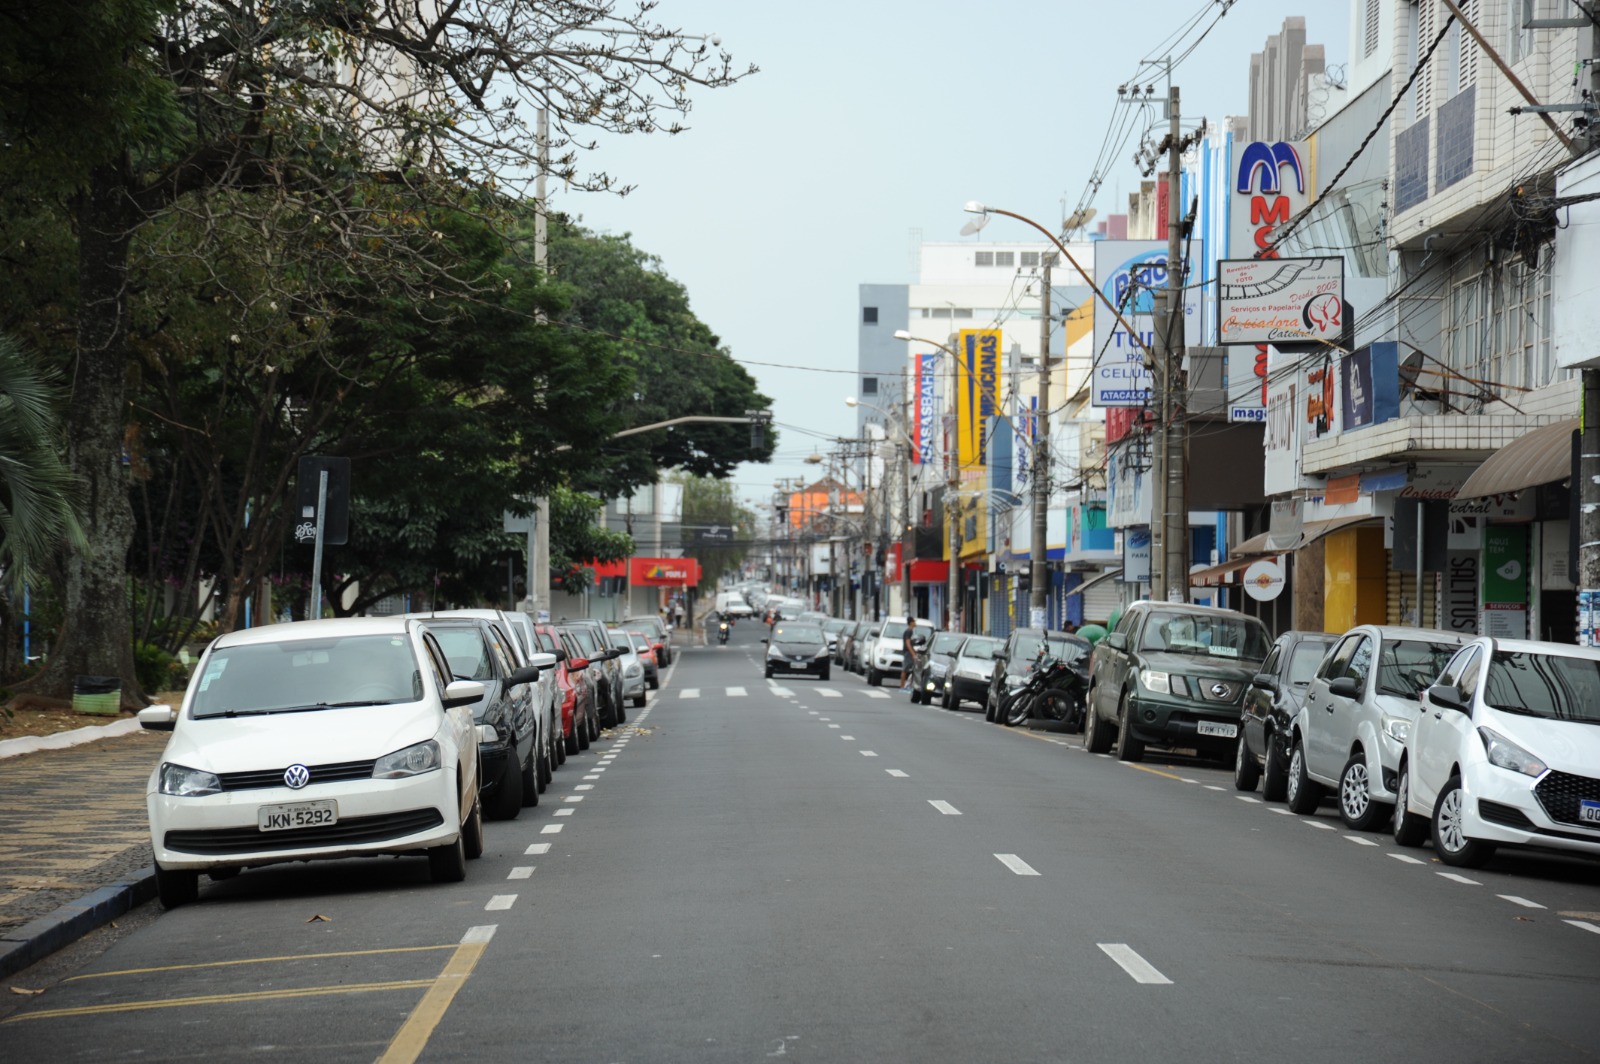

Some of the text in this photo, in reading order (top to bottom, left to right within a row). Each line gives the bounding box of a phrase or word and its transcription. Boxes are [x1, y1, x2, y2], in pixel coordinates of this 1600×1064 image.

[1235, 276, 1253, 284] FOTO
[1289, 280, 1338, 303] Desde 2003
[1230, 305, 1260, 313] Serviços
[1268, 304, 1302, 313] Papelaria
[1102, 391, 1146, 400] ATACADO
[1489, 546, 1505, 554] TEM
[1504, 565, 1514, 575] oi
